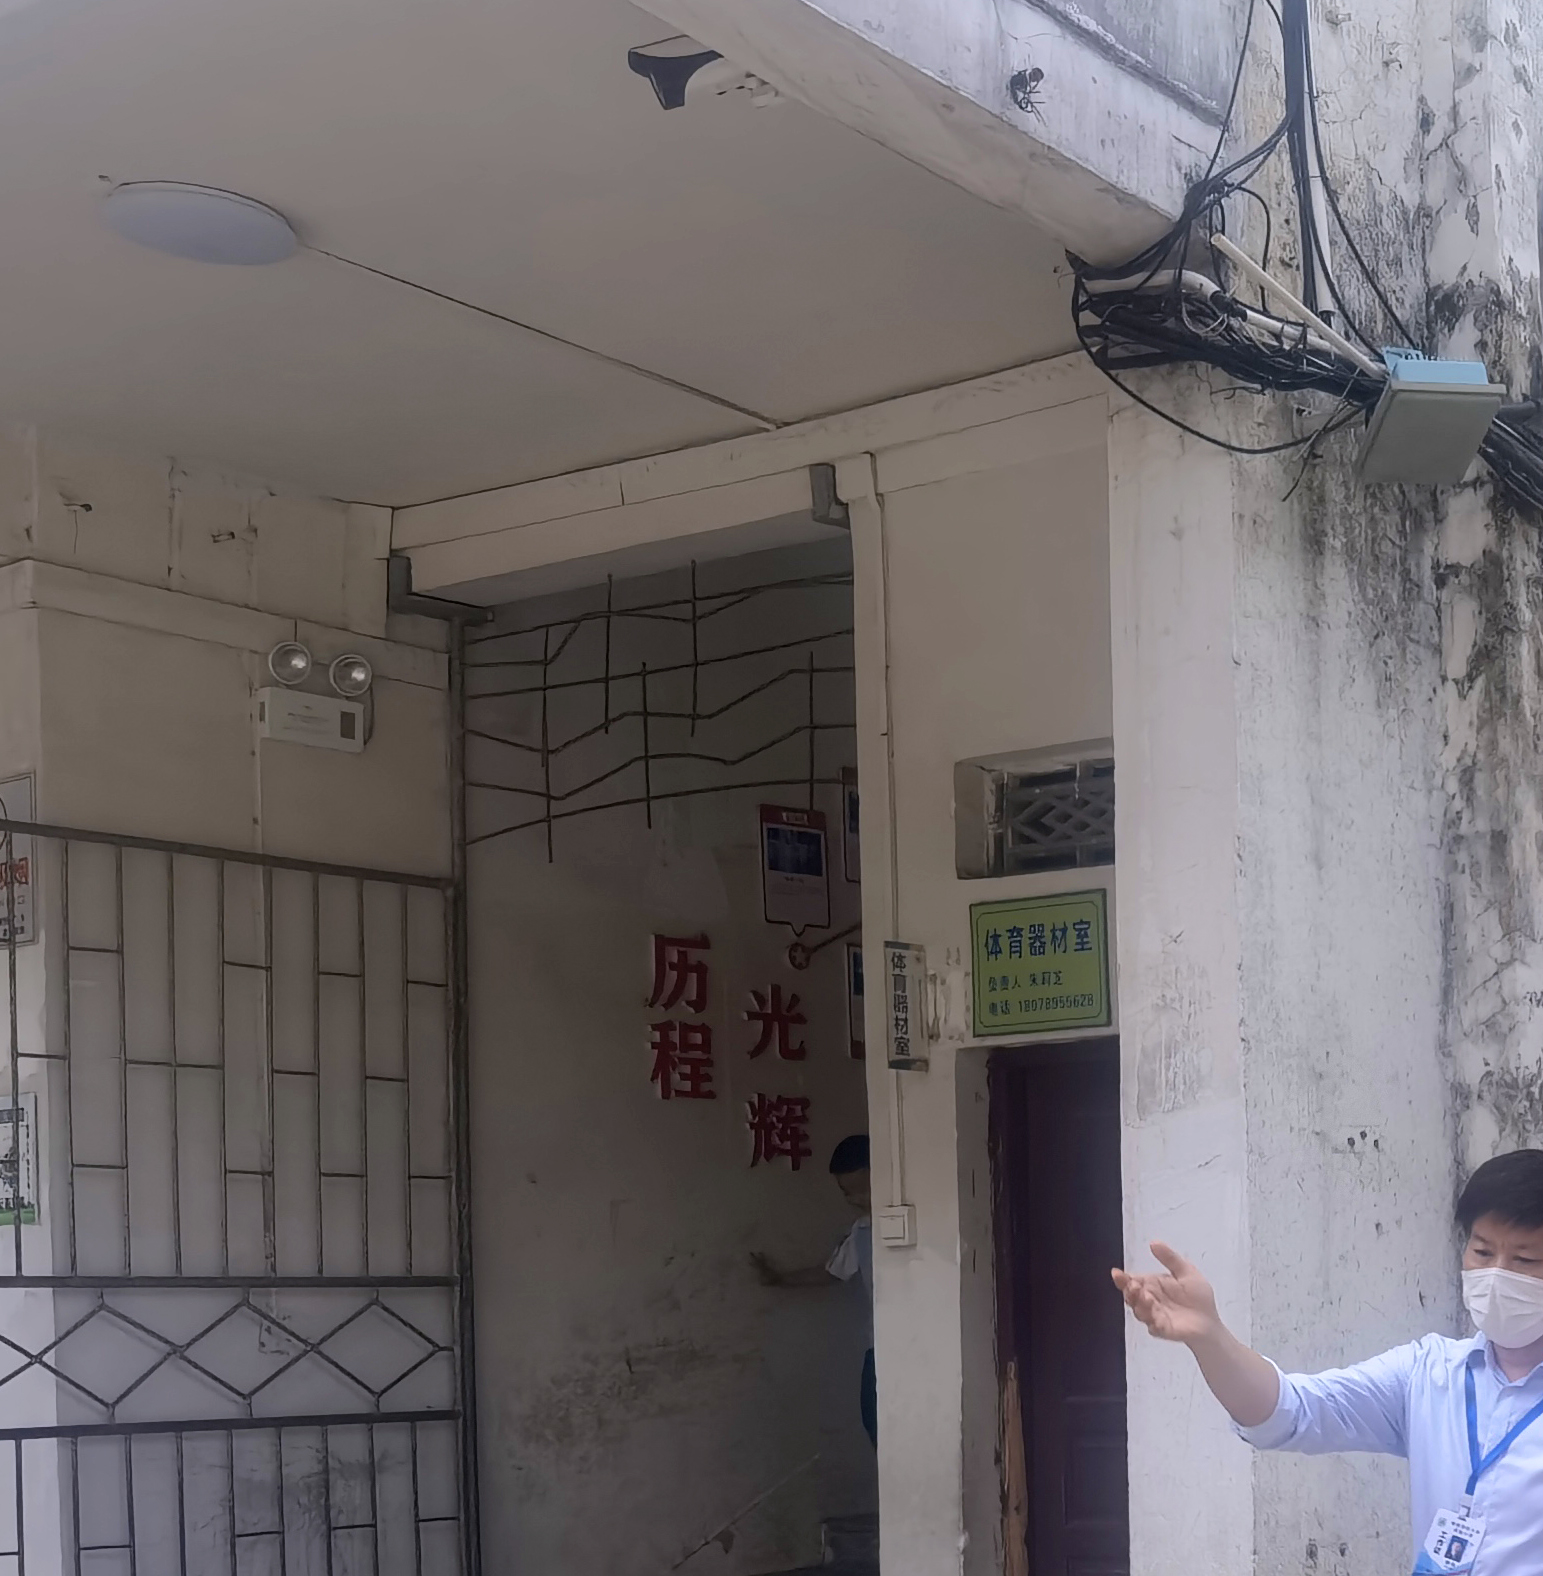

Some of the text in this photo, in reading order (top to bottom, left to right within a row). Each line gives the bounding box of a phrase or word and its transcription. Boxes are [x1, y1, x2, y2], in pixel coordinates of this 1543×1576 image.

[984, 919, 1093, 961] 体育器材室
[645, 933, 717, 1100] 历程
[891, 951, 910, 1057] 体育器材室
[988, 999, 1011, 1016] 电话
[745, 983, 814, 1171] 光辉
